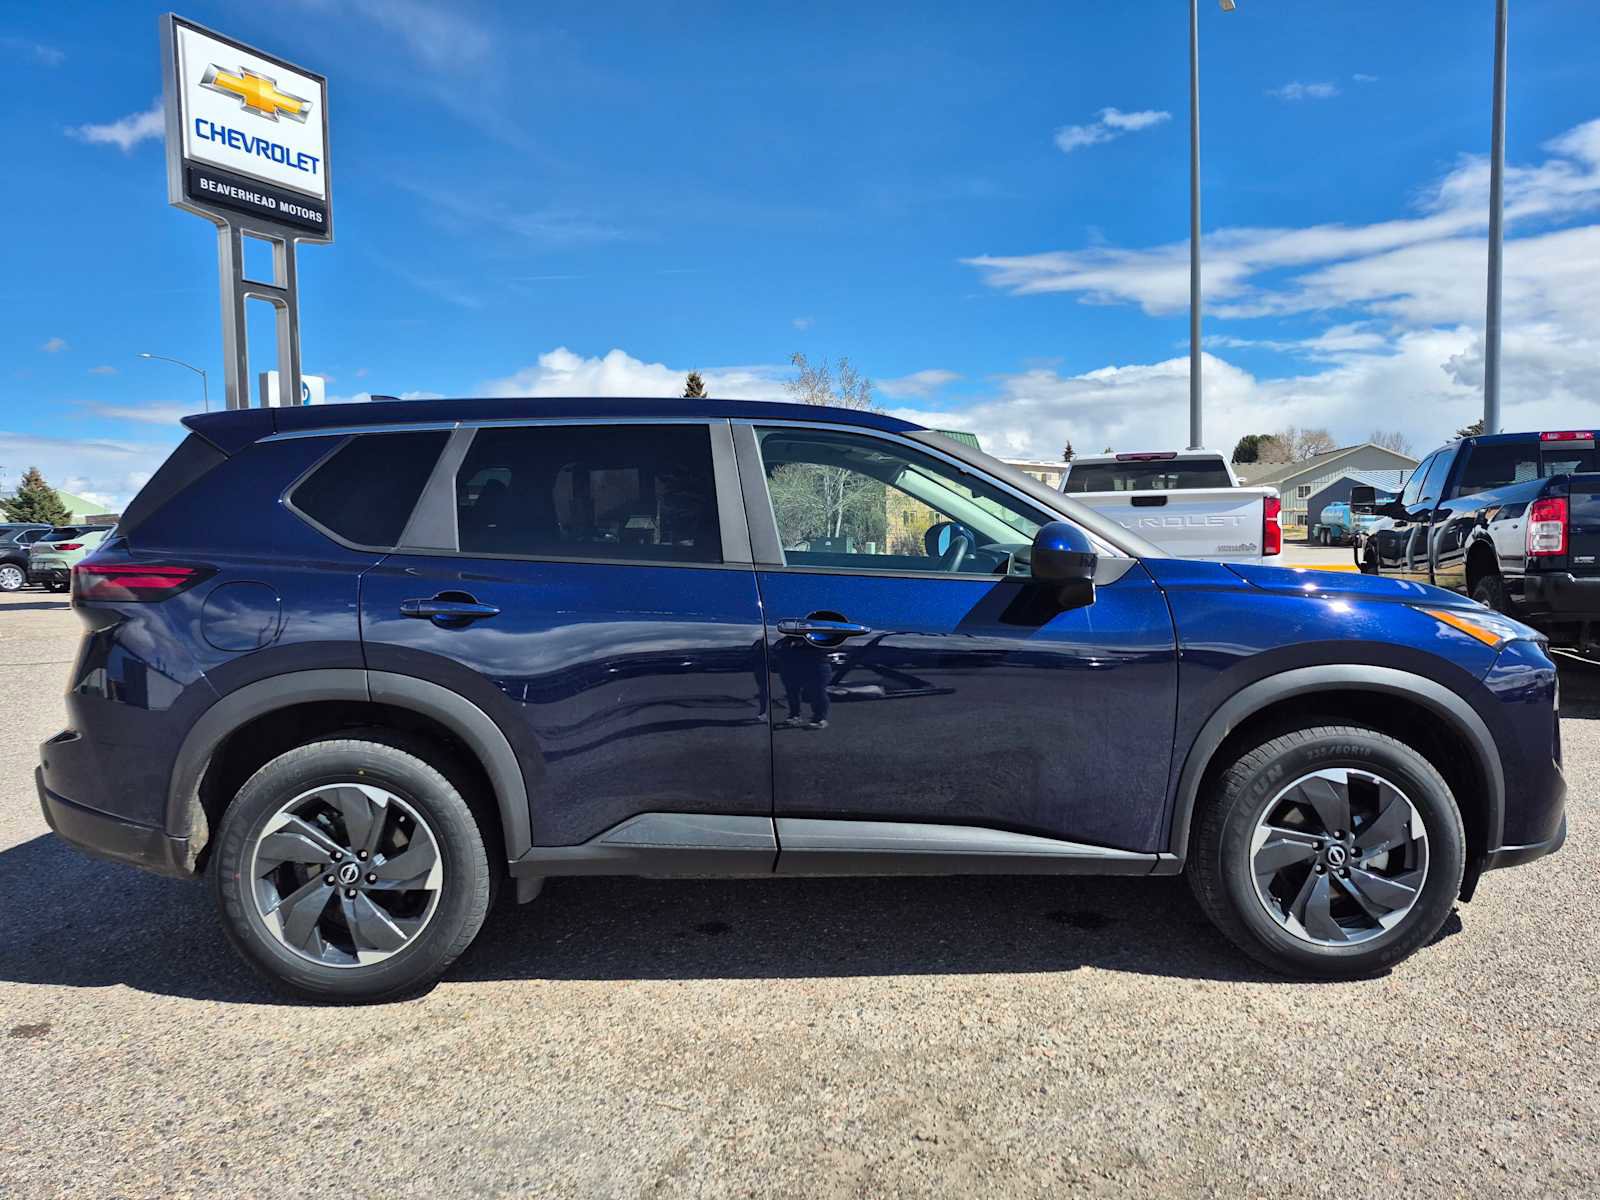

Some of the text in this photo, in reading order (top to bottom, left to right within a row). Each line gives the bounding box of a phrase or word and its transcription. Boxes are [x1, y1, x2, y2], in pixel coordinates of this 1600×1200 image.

[195, 118, 320, 174] CHEVROLET
[200, 178, 323, 223] BEAVERHEAD MOTORS
[1118, 514, 1248, 528] VROLET
